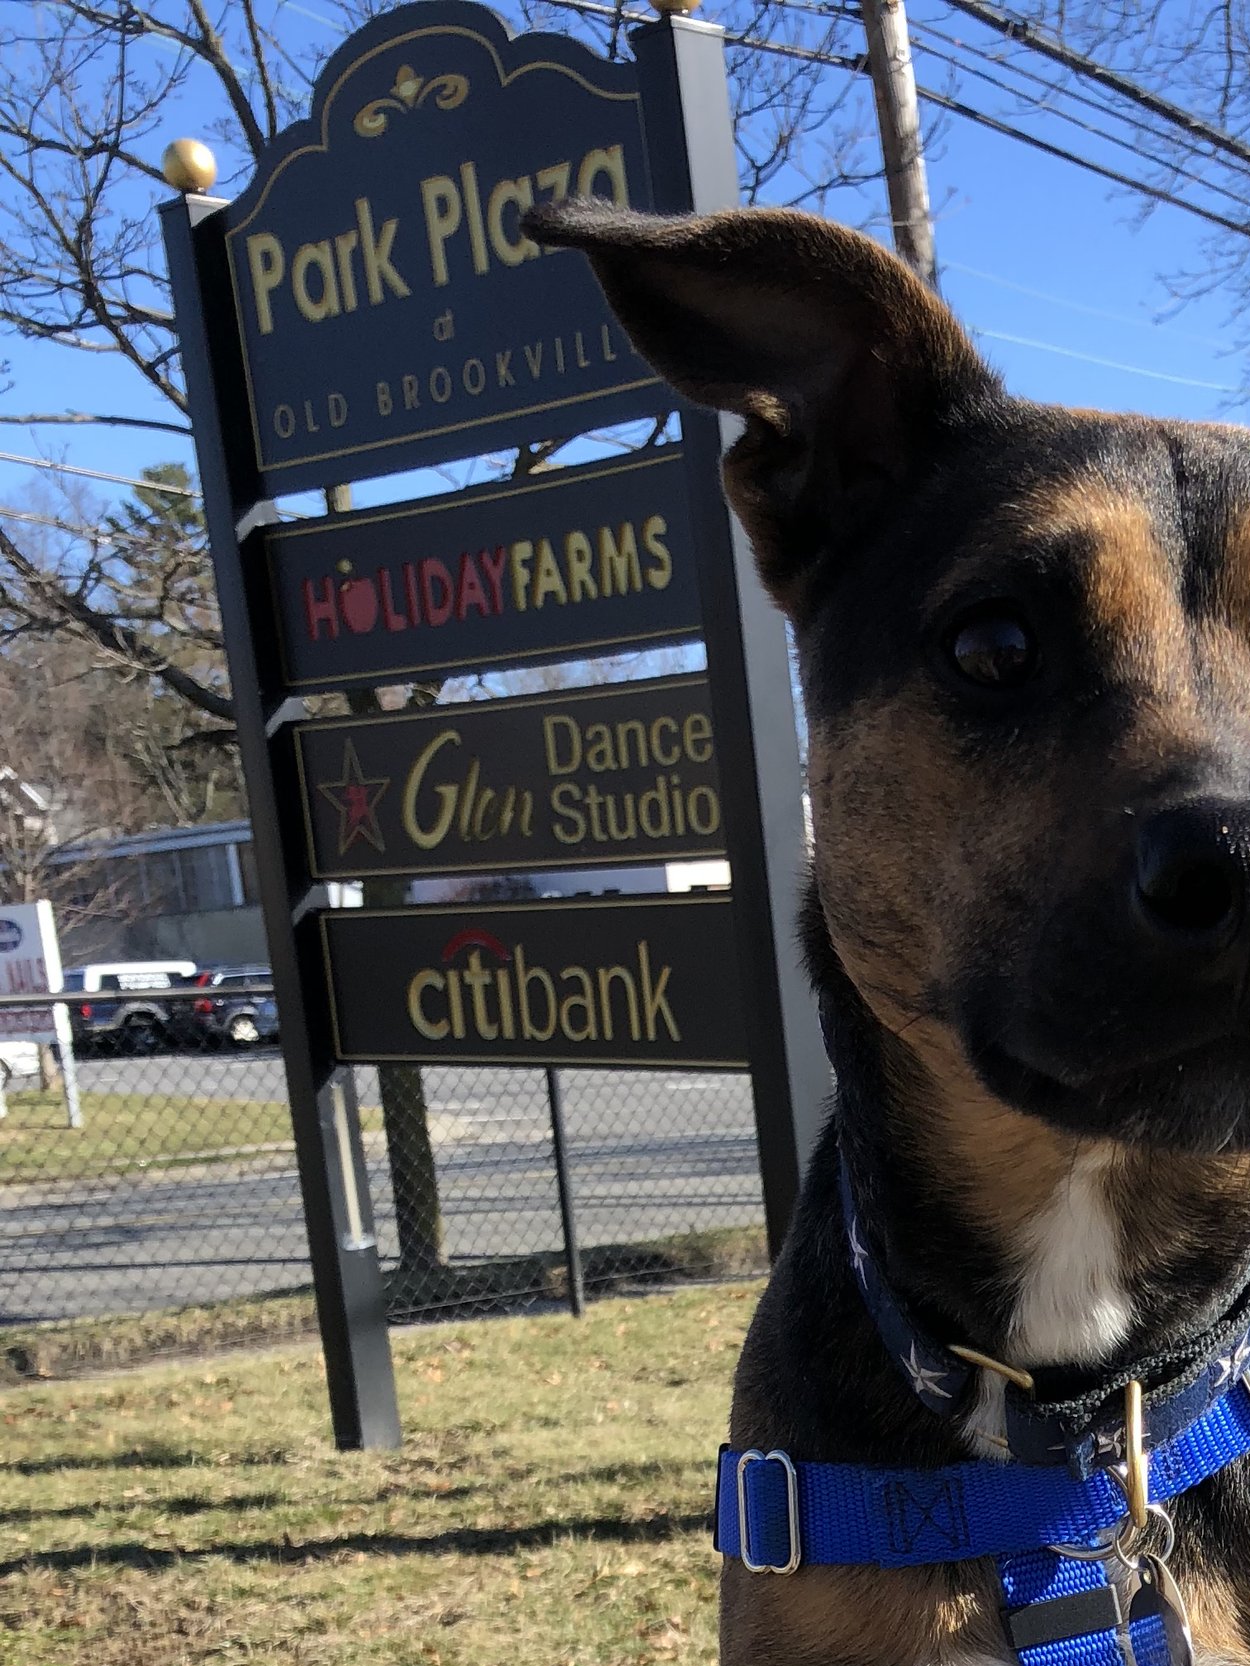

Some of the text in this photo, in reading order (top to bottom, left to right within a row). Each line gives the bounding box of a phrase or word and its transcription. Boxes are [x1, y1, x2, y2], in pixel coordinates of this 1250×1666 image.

[246, 196, 413, 335] Park
[432, 309, 455, 341] at
[273, 324, 634, 439] OLD BROOKVILL
[402, 728, 534, 850] Glen
[543, 712, 714, 776] Dance
[552, 772, 721, 844] Studio
[407, 939, 683, 1042] citibank
